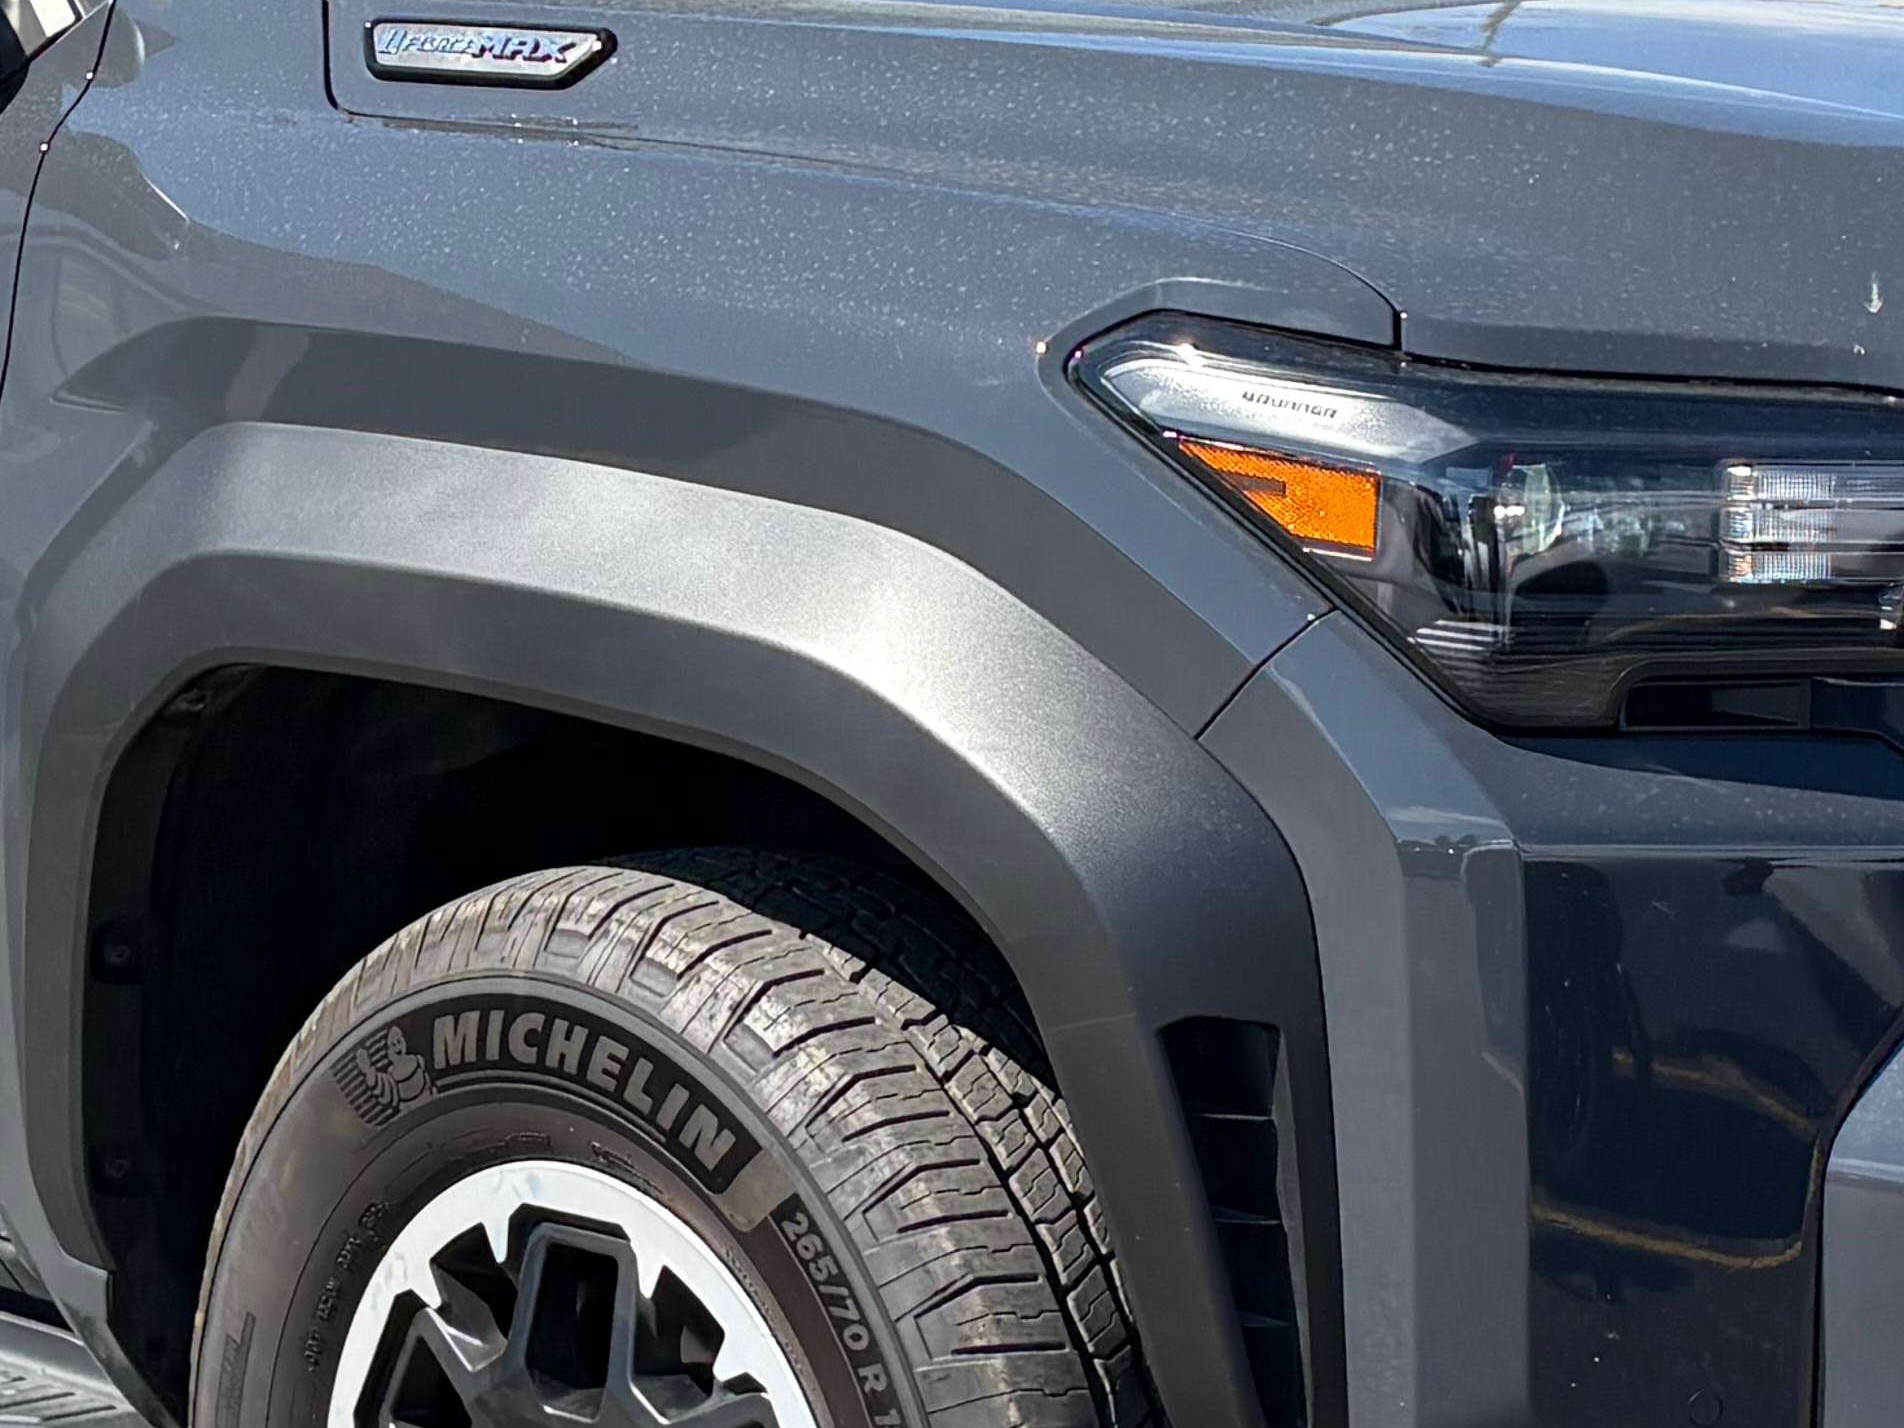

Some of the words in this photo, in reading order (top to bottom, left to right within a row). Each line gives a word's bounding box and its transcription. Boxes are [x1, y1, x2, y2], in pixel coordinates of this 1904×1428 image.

[432, 1011, 736, 1172] MICHELIN
[779, 1209, 871, 1353] 265/70
[858, 1365, 891, 1396] R
